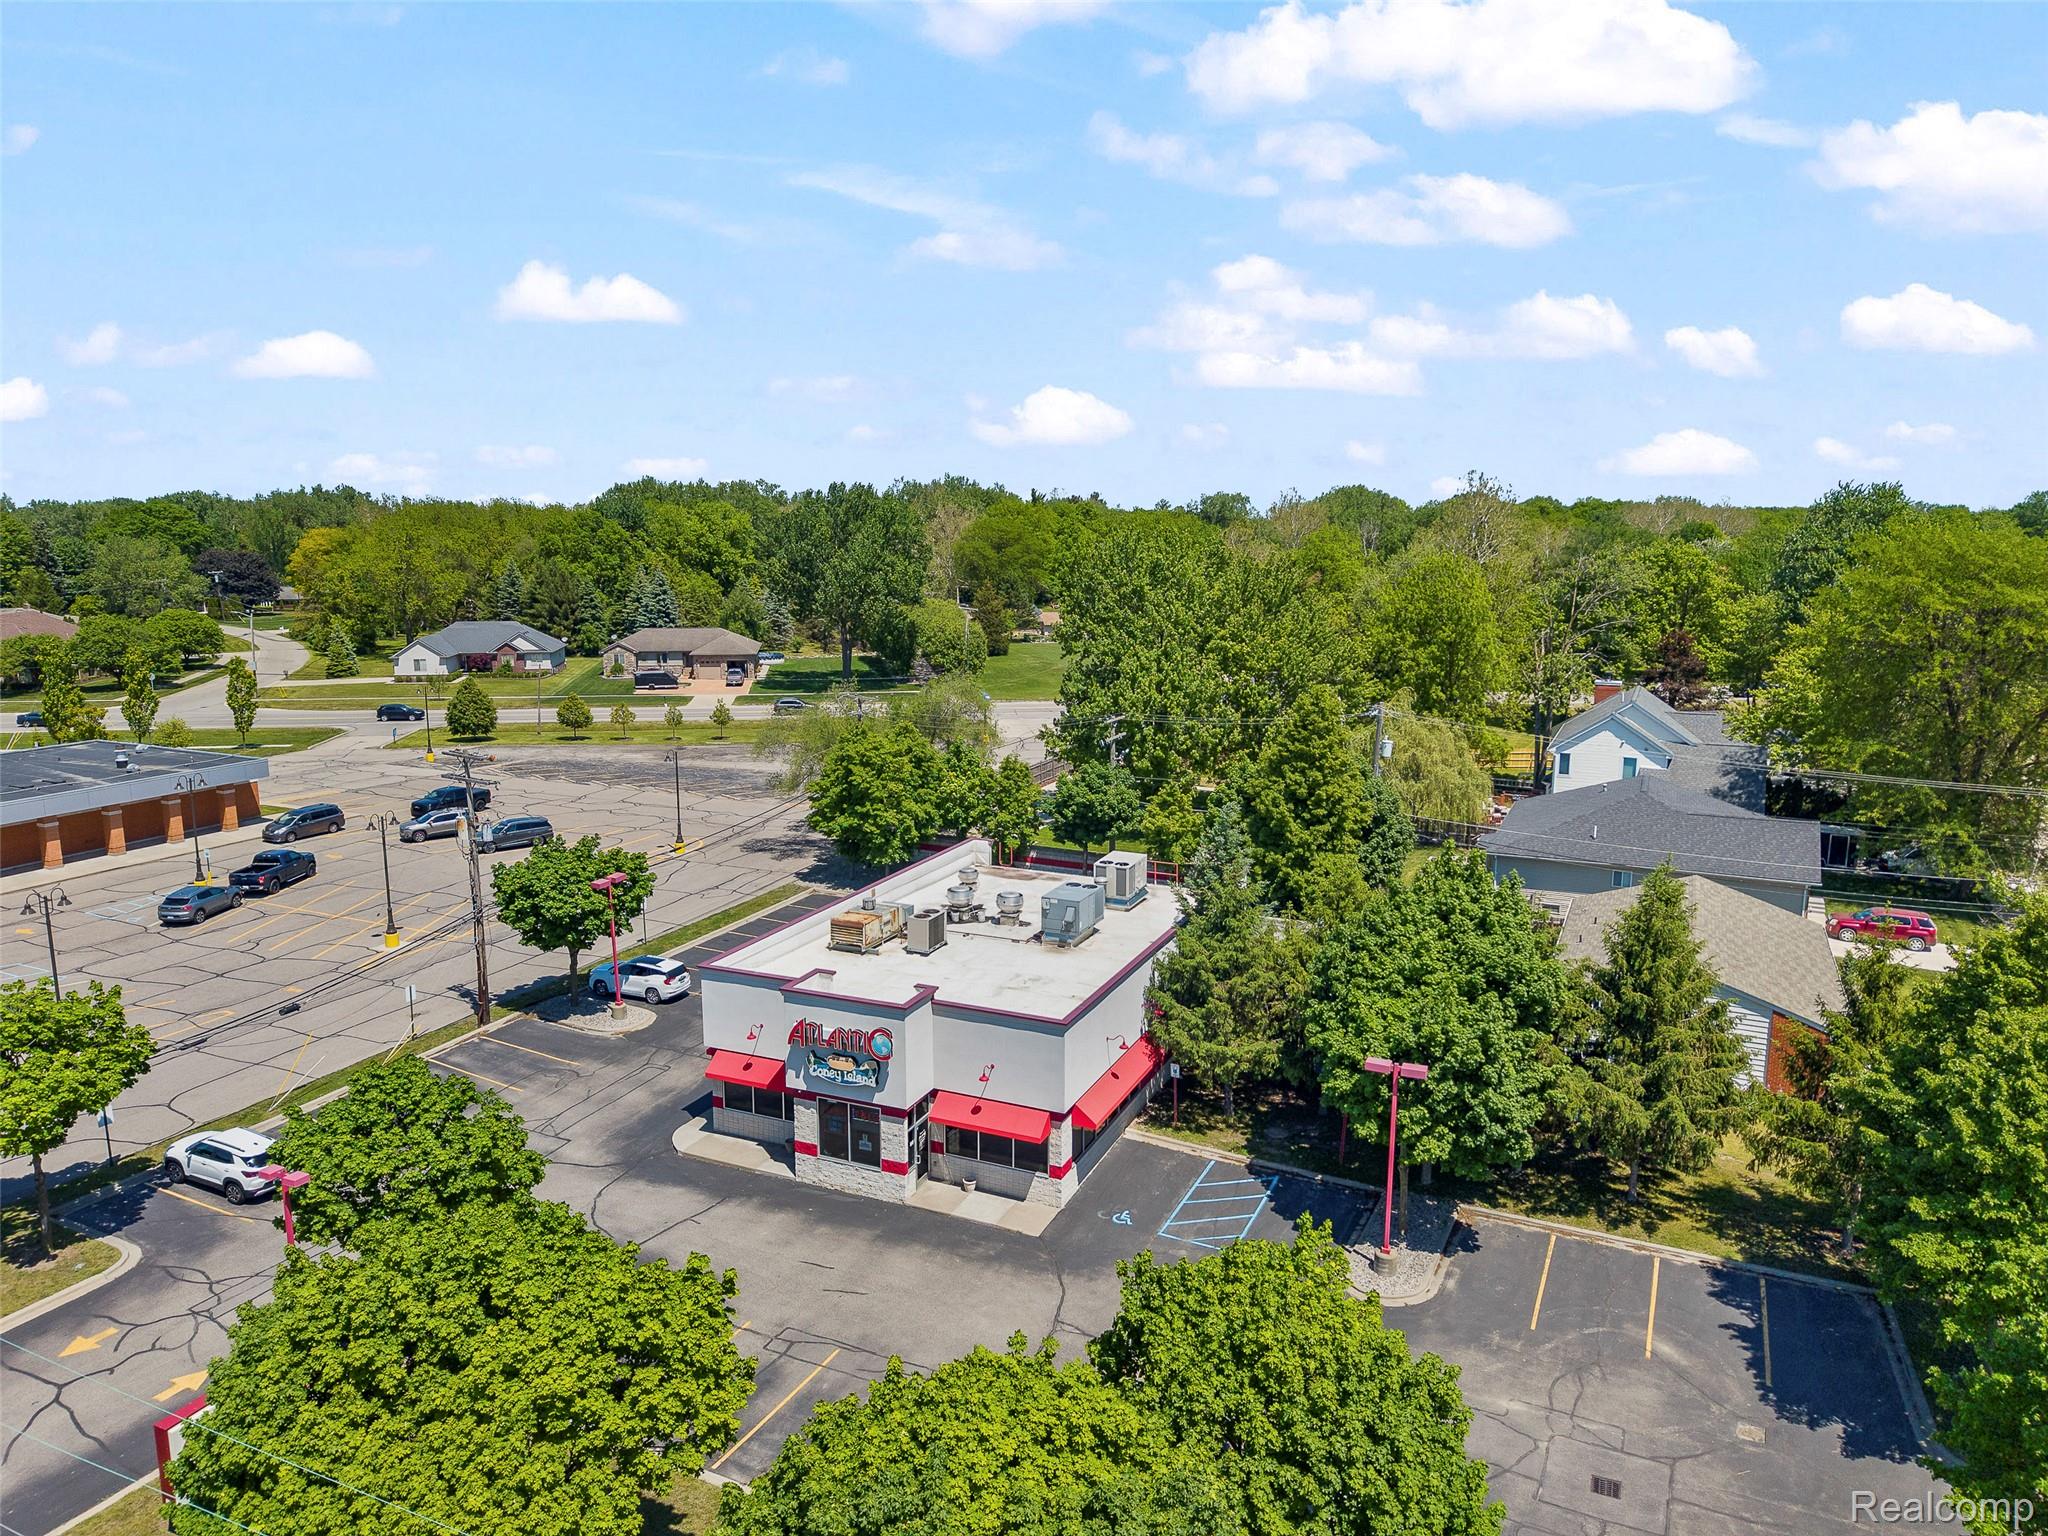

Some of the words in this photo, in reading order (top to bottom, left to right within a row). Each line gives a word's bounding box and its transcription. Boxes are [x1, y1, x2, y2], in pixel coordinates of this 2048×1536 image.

[788, 1019, 893, 1061] ATLANTIC
[809, 1065, 842, 1083] Coney
[843, 1071, 877, 1087] Island
